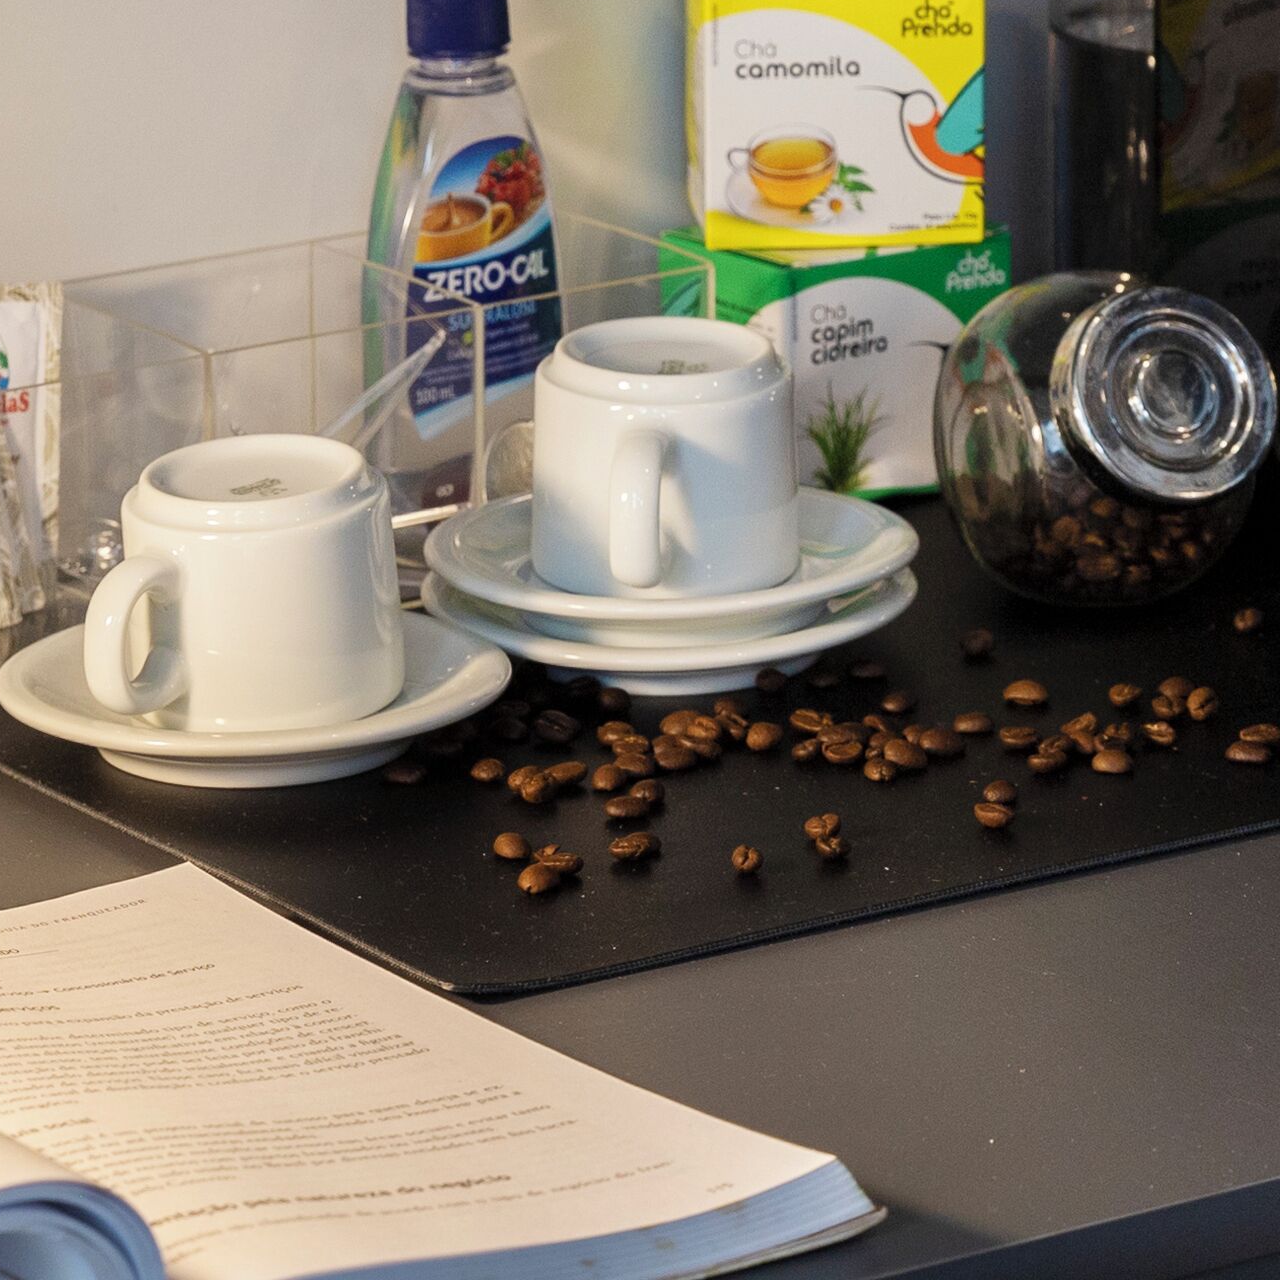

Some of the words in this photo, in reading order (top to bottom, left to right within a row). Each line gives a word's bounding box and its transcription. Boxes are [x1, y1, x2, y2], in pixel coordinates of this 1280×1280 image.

[901, 17, 974, 39] Prenda
[735, 56, 861, 80] camomila
[423, 249, 550, 303] ZERO-CAL
[811, 318, 874, 344] capim
[54, 898, 147, 924] FRANQUEADOR
[150, 971, 165, 980] de
[167, 962, 215, 978] Serviço
[225, 994, 243, 1004] de
[194, 1019, 213, 1028] de
[276, 1003, 315, 1013] como
[300, 1009, 321, 1018] de
[294, 1029, 314, 1039] de
[396, 1184, 425, 1194] do
